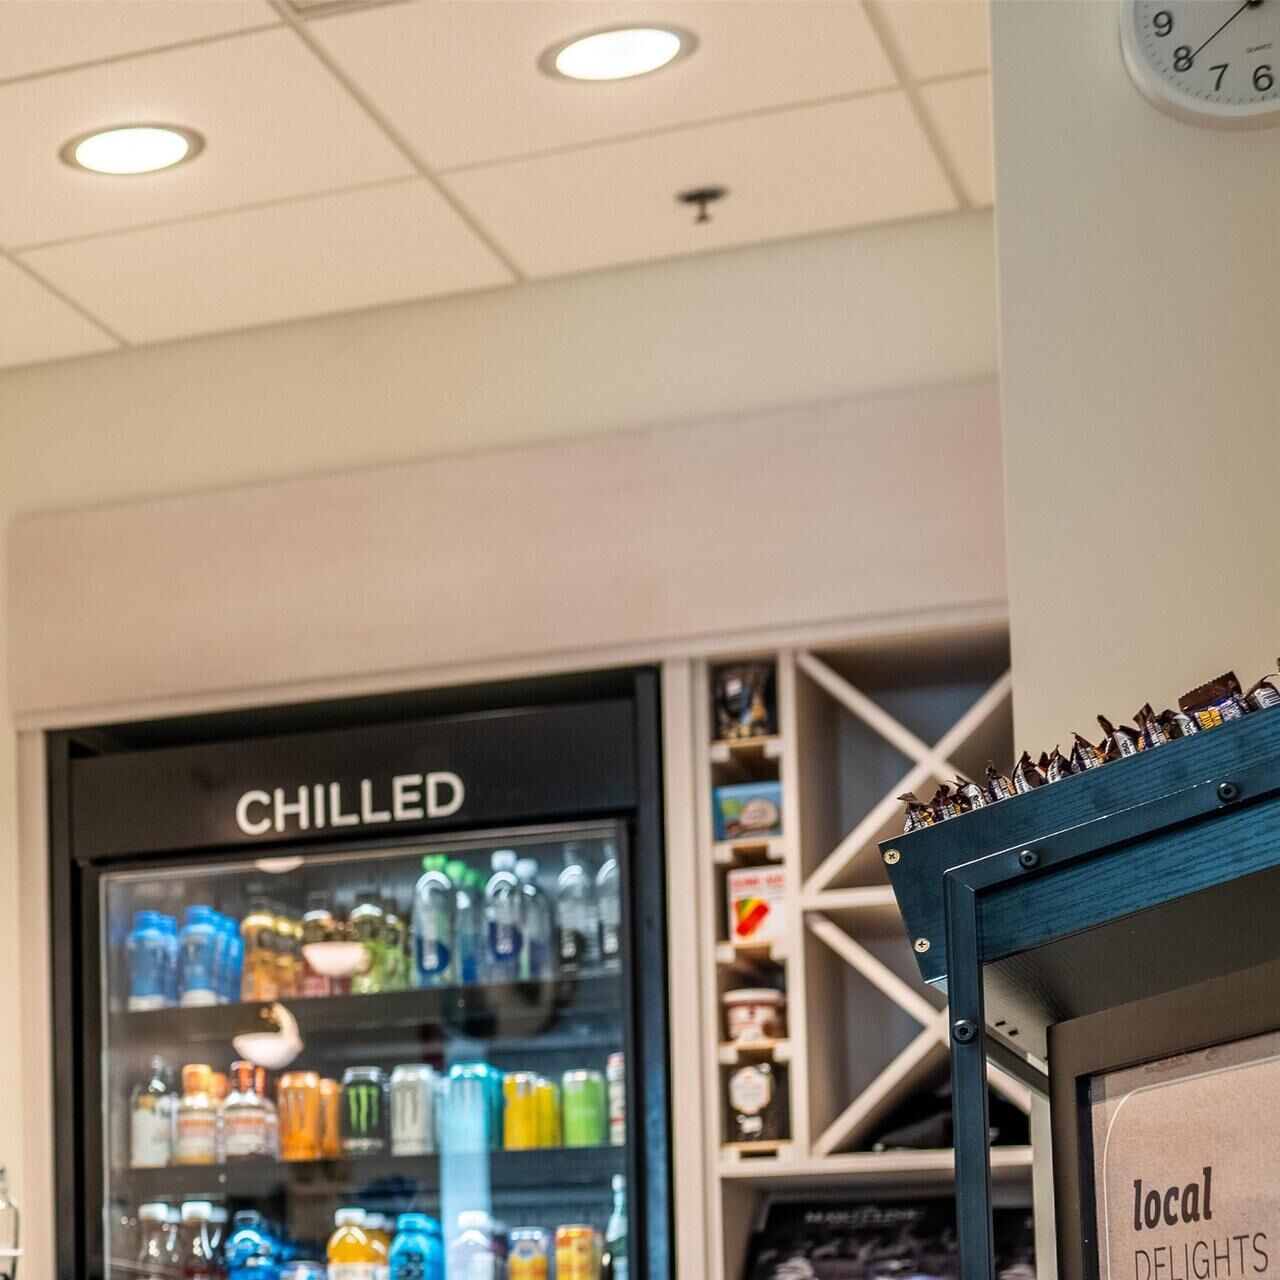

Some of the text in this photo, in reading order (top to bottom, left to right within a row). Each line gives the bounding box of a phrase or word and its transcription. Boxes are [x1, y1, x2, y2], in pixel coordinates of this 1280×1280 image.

[1153, 10, 1173, 38] 9
[1173, 46, 1193, 73] 8
[1209, 64, 1229, 91] 7
[1252, 65, 1273, 91] 6
[236, 771, 466, 836] CHILLED
[1133, 1166, 1212, 1231] local
